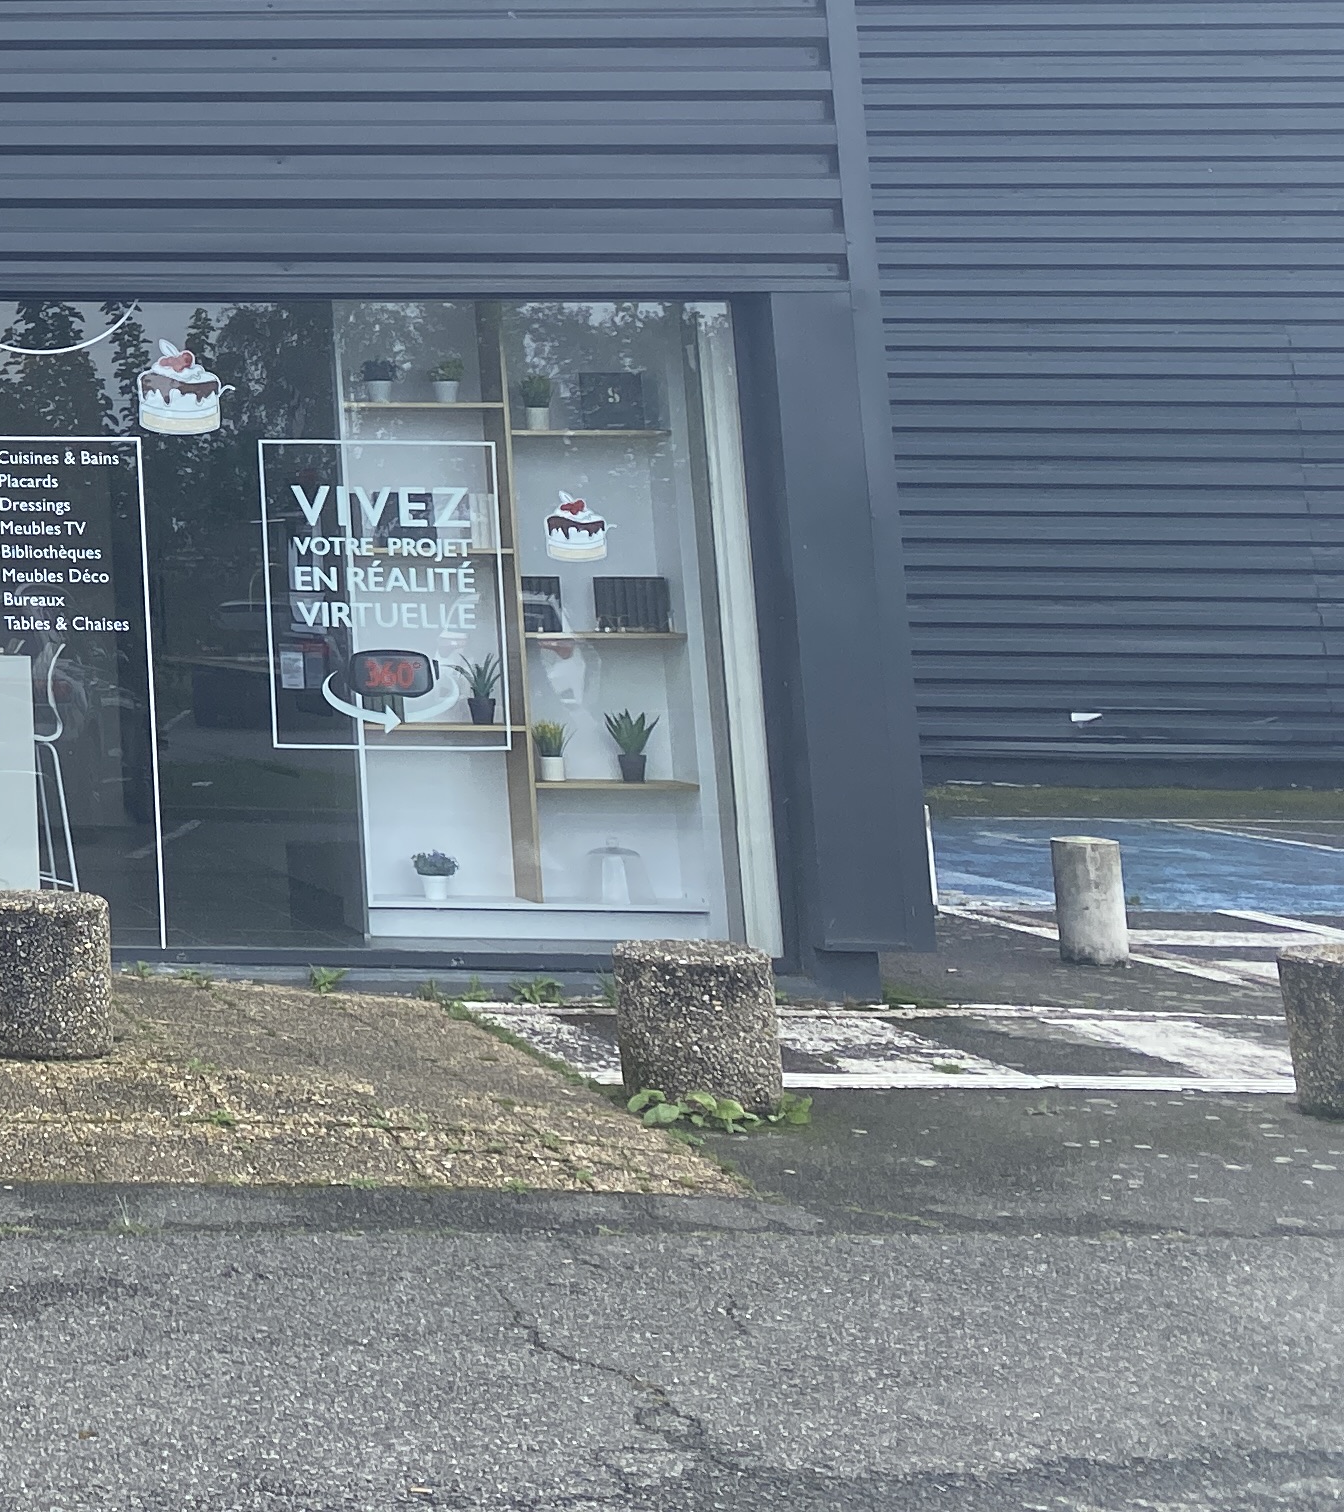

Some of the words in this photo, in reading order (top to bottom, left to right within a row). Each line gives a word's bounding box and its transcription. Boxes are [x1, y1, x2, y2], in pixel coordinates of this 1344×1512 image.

[64, 451, 76, 465] &
[80, 450, 119, 465] Bains
[290, 485, 471, 528] VIVEZ
[0, 520, 61, 536] Meubles
[63, 521, 86, 536] TV
[0, 544, 102, 563] Bibliothèques
[293, 537, 375, 556] VOTRE
[387, 538, 473, 562] PROJET
[2, 568, 64, 583] Meubles
[68, 568, 110, 583] Déco
[294, 566, 338, 592] EN
[346, 560, 477, 593] RÉALITÉ
[3, 591, 66, 607] Bureaux
[4, 615, 51, 631] Tables
[55, 616, 68, 631] &
[72, 616, 130, 631] Chaises
[296, 601, 477, 630] VIRTUELLE
